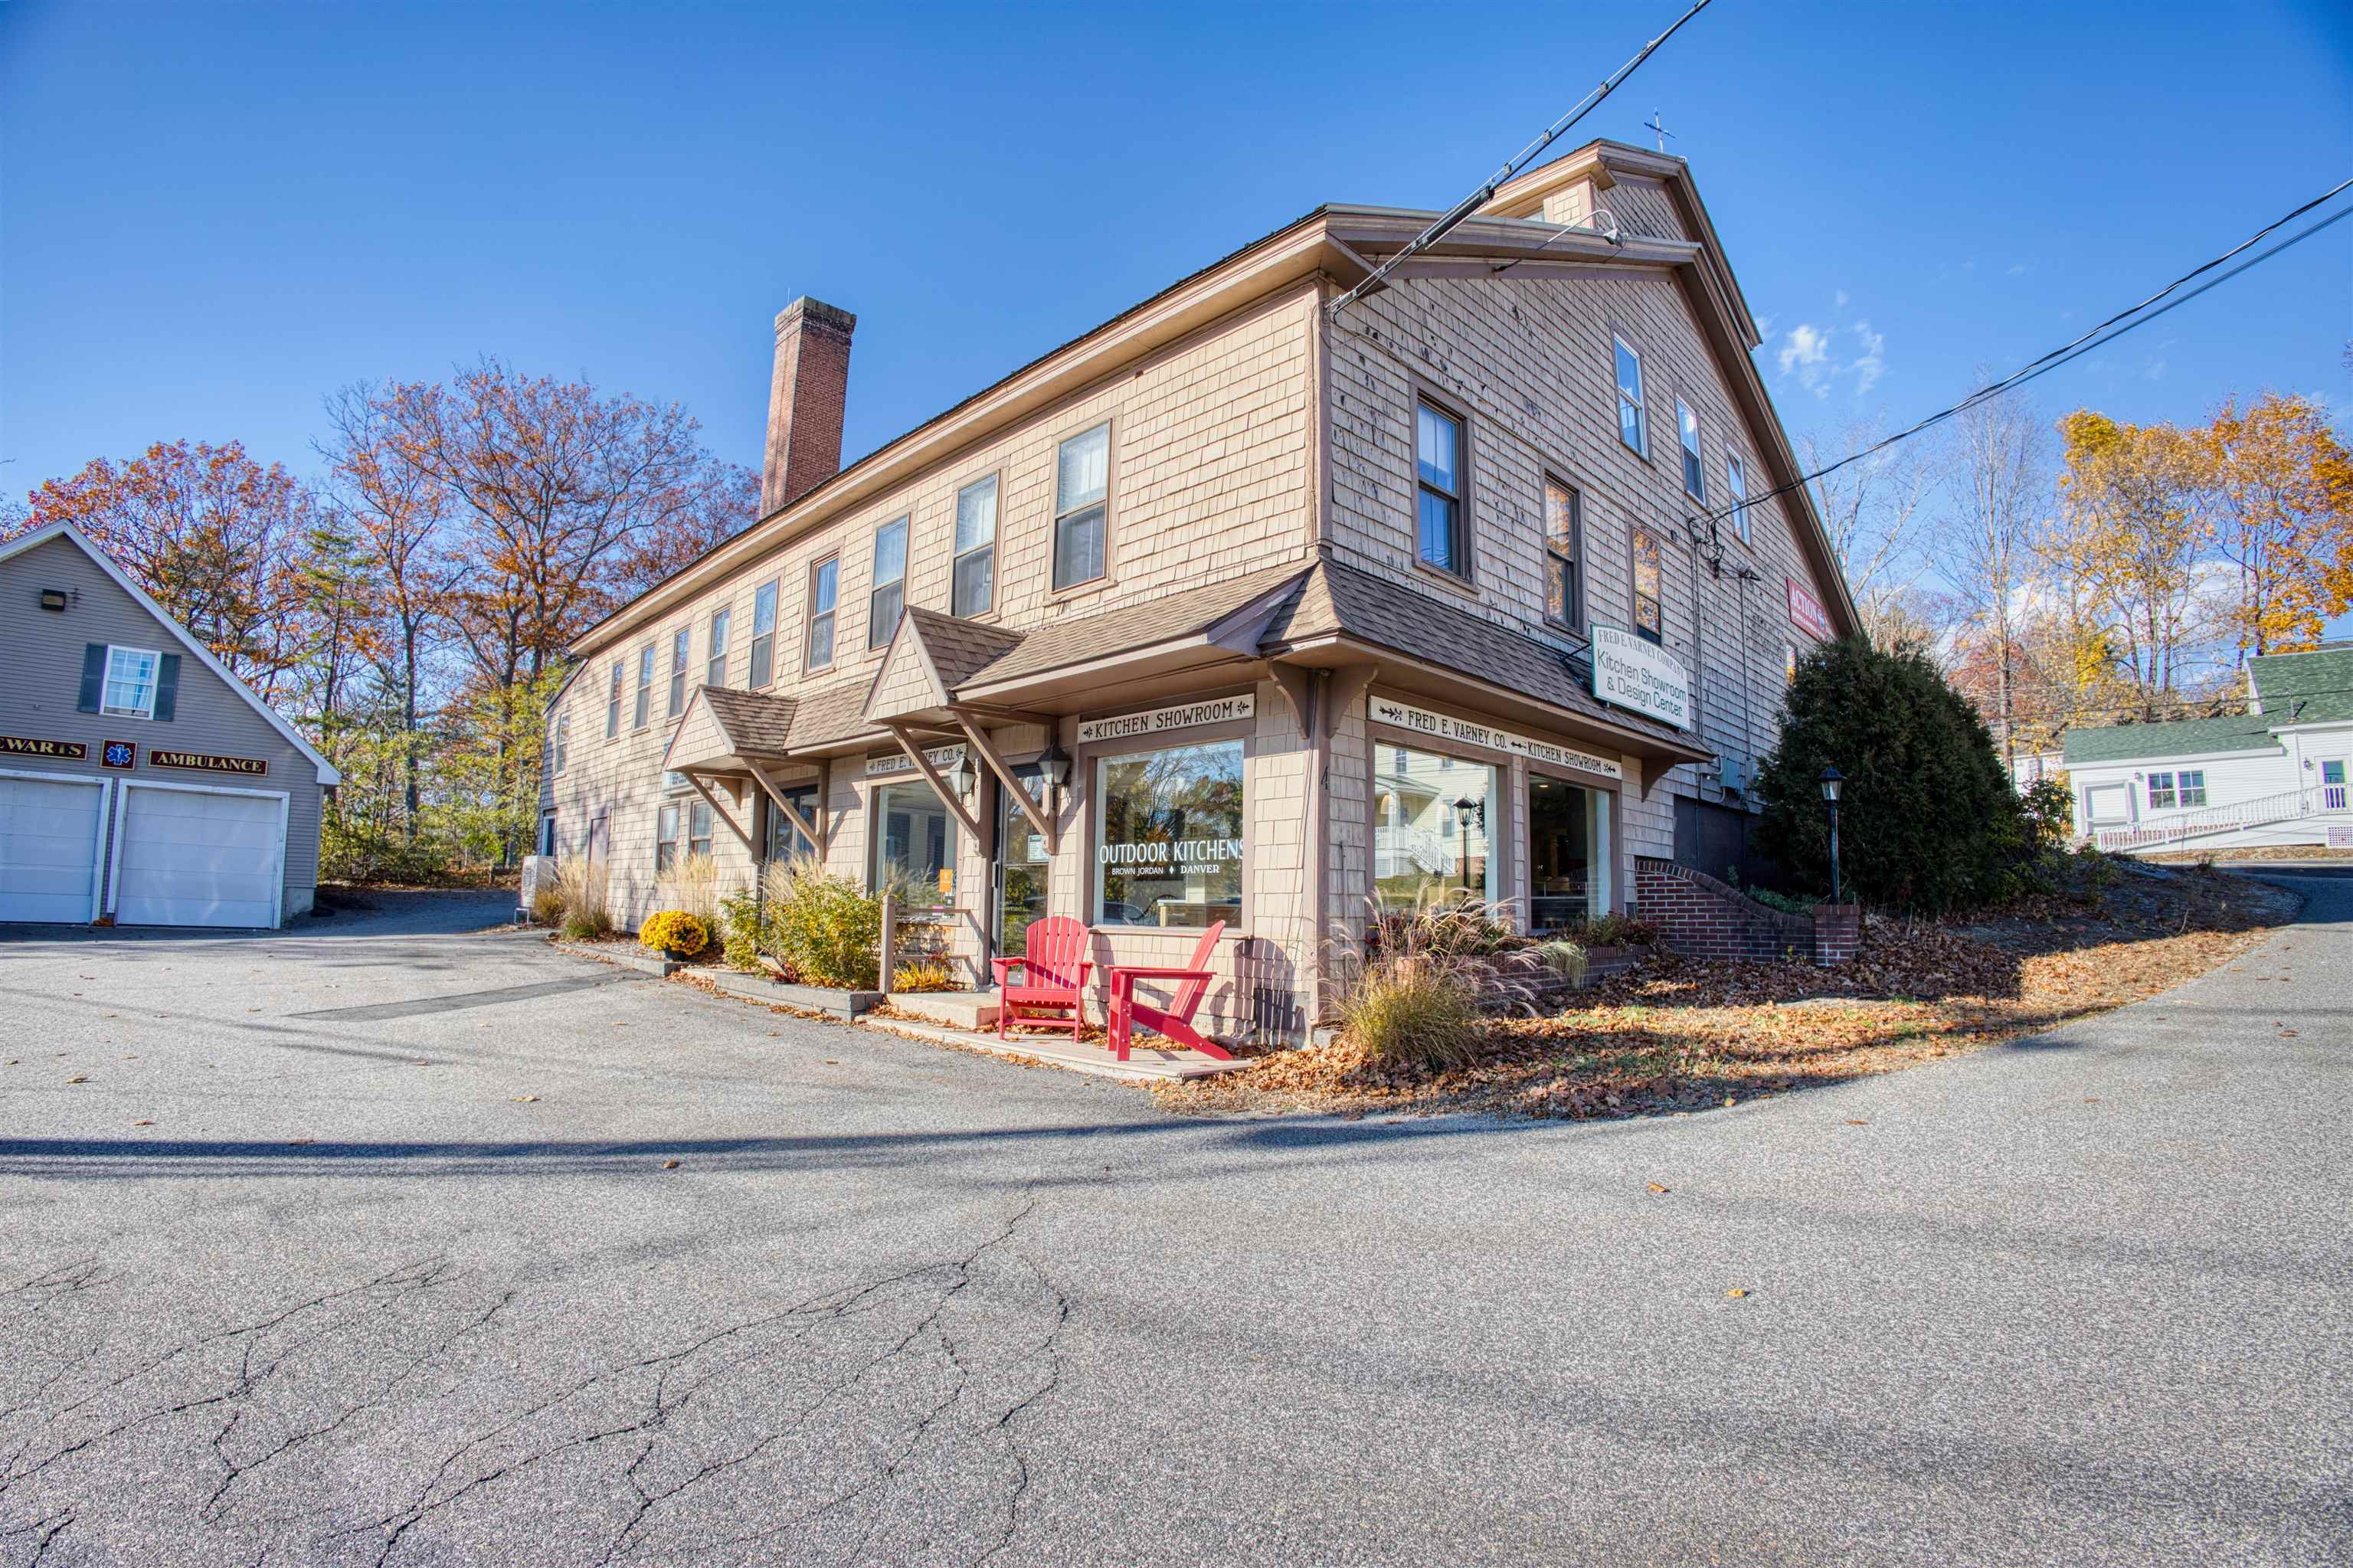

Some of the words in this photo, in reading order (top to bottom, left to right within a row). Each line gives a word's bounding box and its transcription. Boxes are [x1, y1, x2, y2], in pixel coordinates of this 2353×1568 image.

[1599, 630, 1620, 647] FRED
[1628, 635, 1656, 660] VARNEY
[1657, 649, 1684, 680] COMPANY
[1597, 649, 1639, 682] Kitchen
[1641, 667, 1687, 702] Showroom
[1607, 676, 1615, 691] &
[1618, 677, 1651, 706] Design
[1095, 715, 1149, 738] KITCHEN
[1156, 701, 1233, 728] SHOWROOM
[1408, 710, 1436, 732] FRED
[1442, 719, 1451, 735] E.
[1453, 722, 1490, 745] VARNEY
[1494, 733, 1507, 748] CO.
[157, 753, 262, 772] AMBULANCE
[875, 758, 895, 772] FRED
[942, 748, 954, 761] CO.
[1528, 741, 1562, 762] KITCHEN
[1564, 751, 1602, 772] SHOWROOM
[1098, 842, 1169, 864] OUTDOOR
[1173, 839, 1244, 862] KITCHENS
[1111, 867, 1136, 876] BROWN
[1137, 866, 1163, 876] JORDAN
[1180, 864, 1220, 874] DANVER
